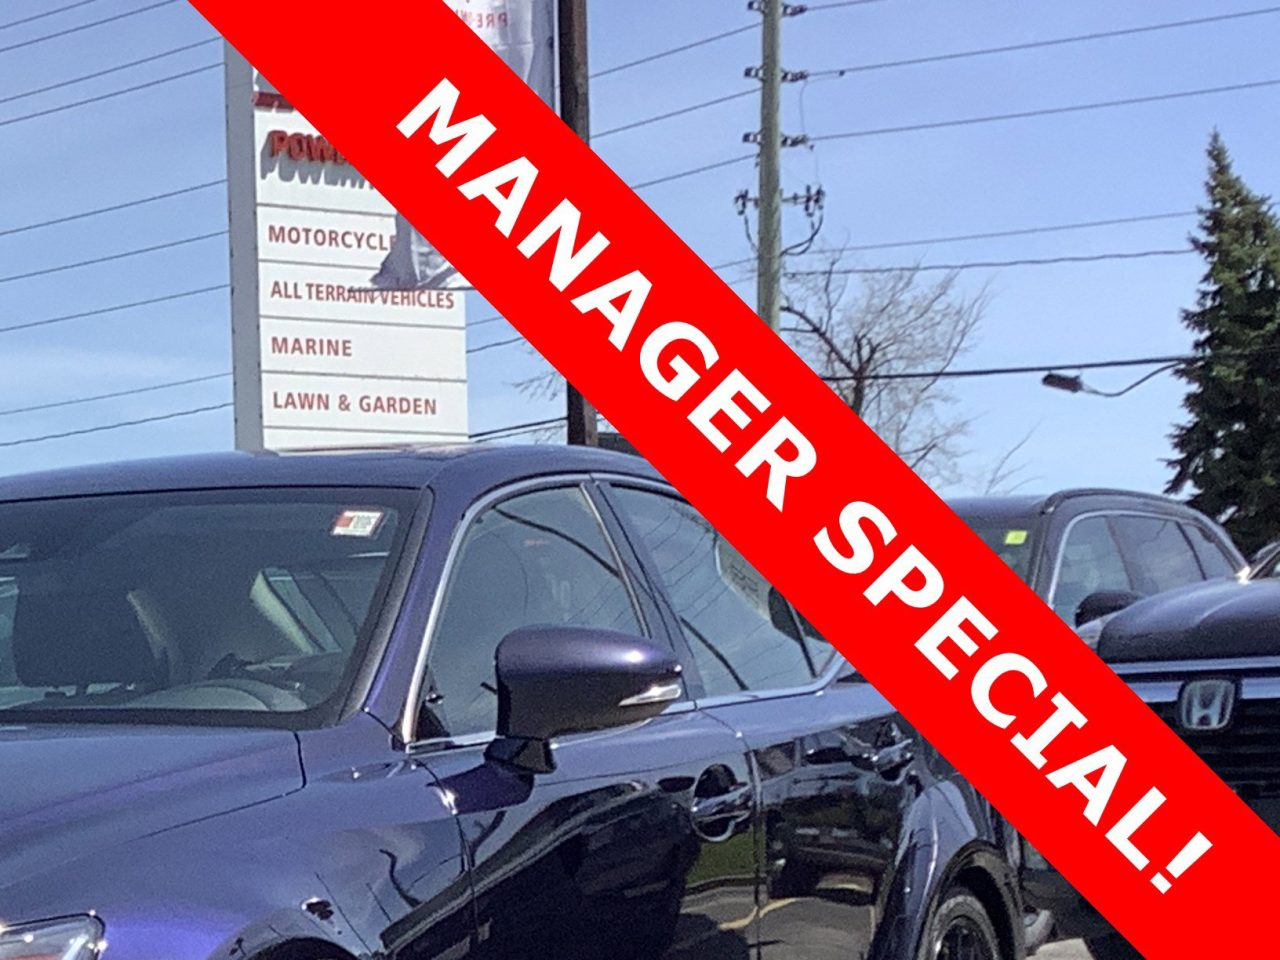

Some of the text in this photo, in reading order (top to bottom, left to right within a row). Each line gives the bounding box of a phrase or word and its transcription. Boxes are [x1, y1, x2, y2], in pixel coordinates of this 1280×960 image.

[270, 280, 455, 310] ALL TERRAIN VEHICLES
[271, 336, 353, 357] MARINE
[272, 391, 438, 416] LAWN & GARDEN
